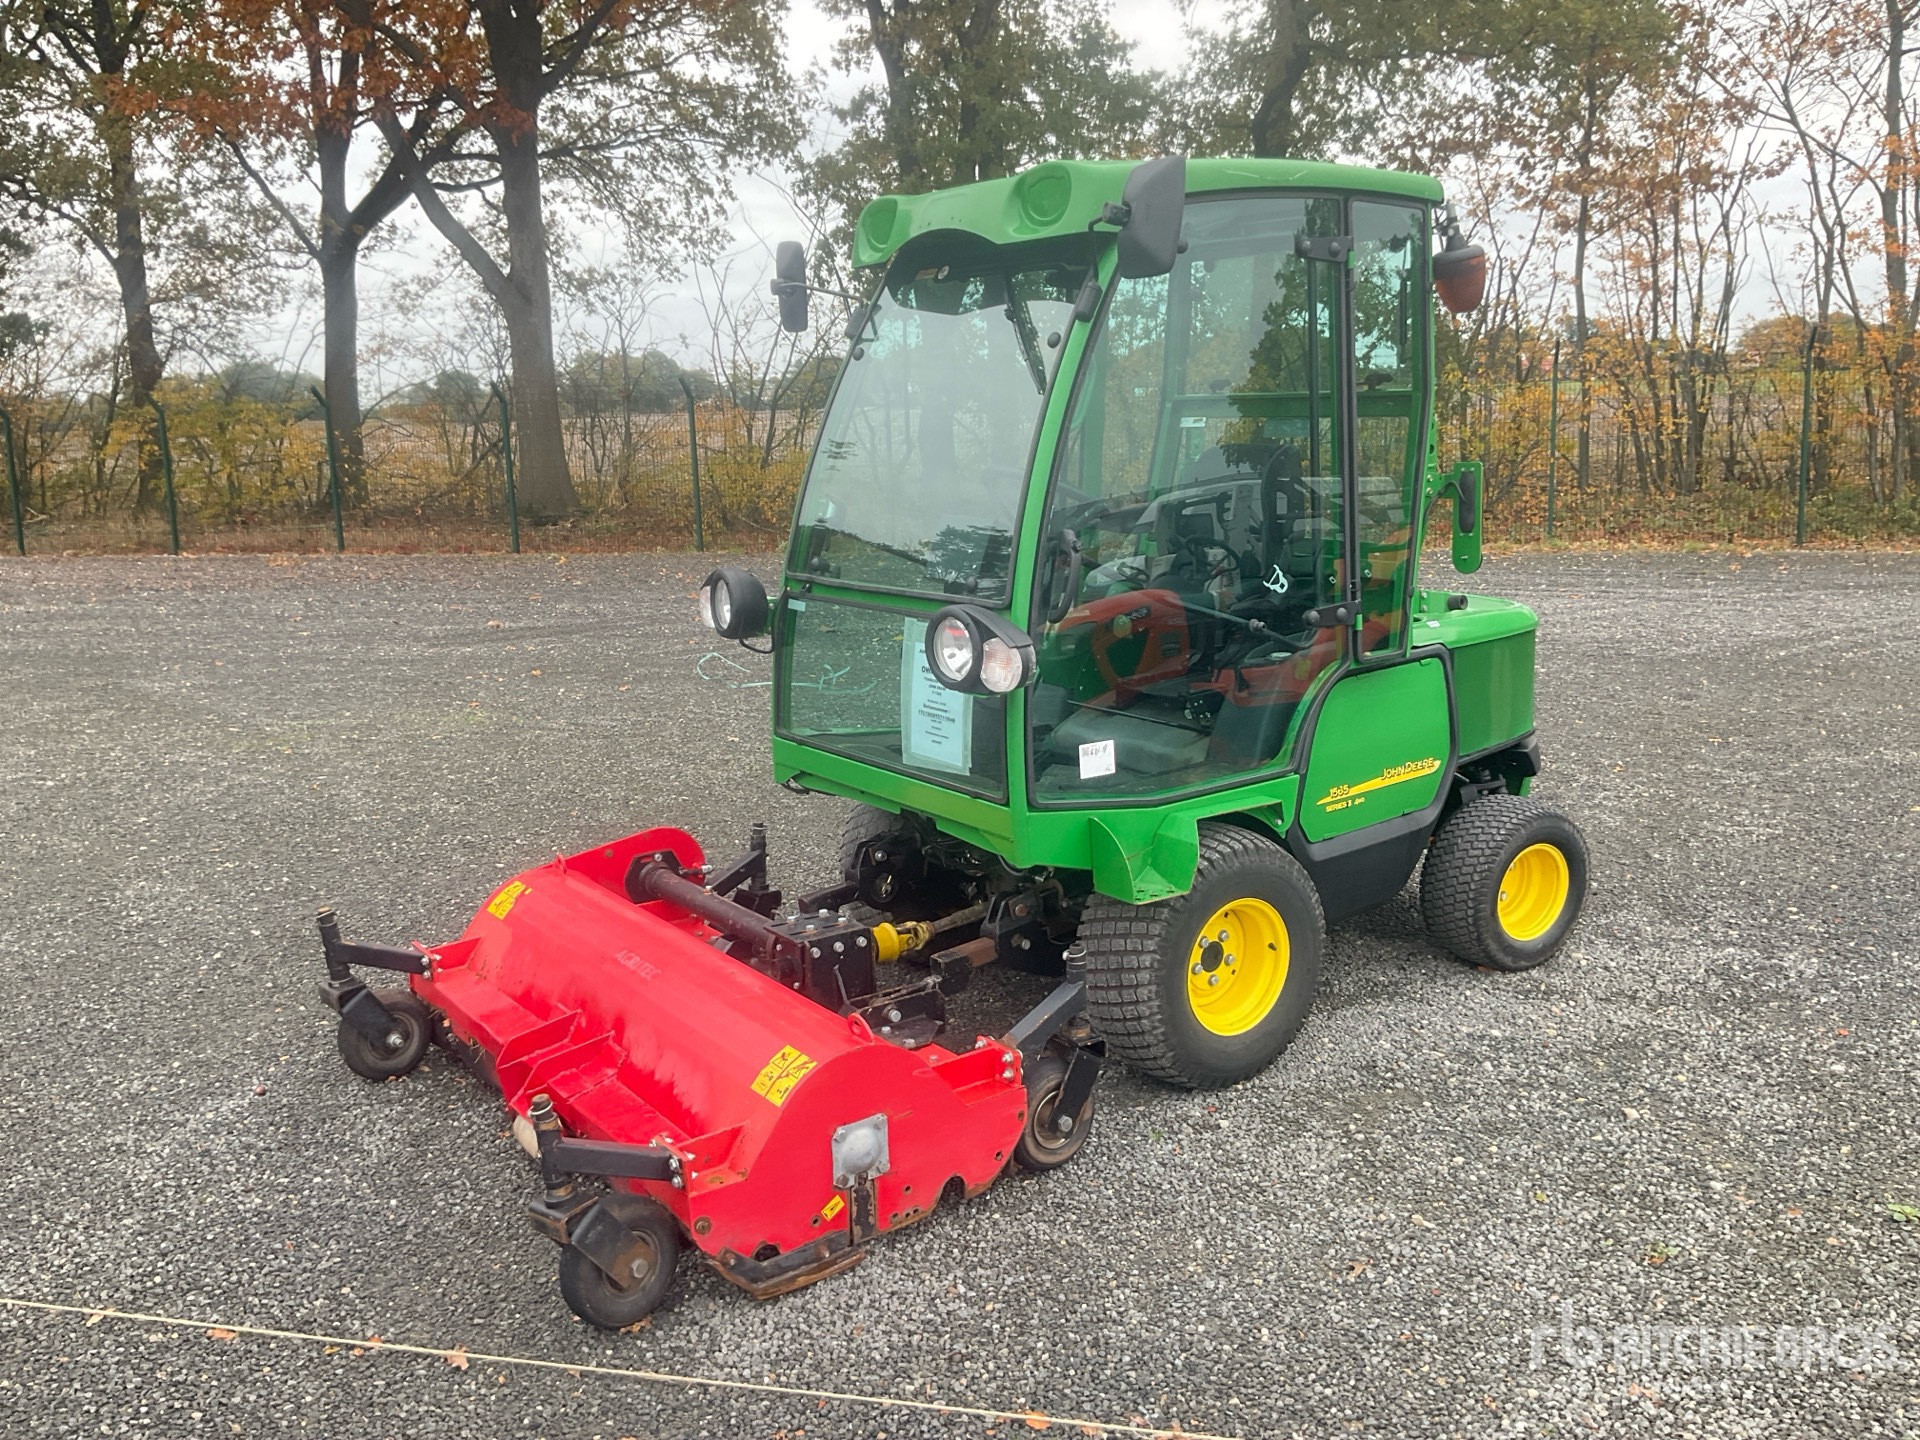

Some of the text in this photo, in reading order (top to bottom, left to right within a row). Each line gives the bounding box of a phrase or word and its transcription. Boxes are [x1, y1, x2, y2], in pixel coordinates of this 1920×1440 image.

[1381, 757, 1435, 780] JOHN DEERE
[1329, 784, 1349, 799] 1565
[1325, 801, 1347, 813] SERIES
